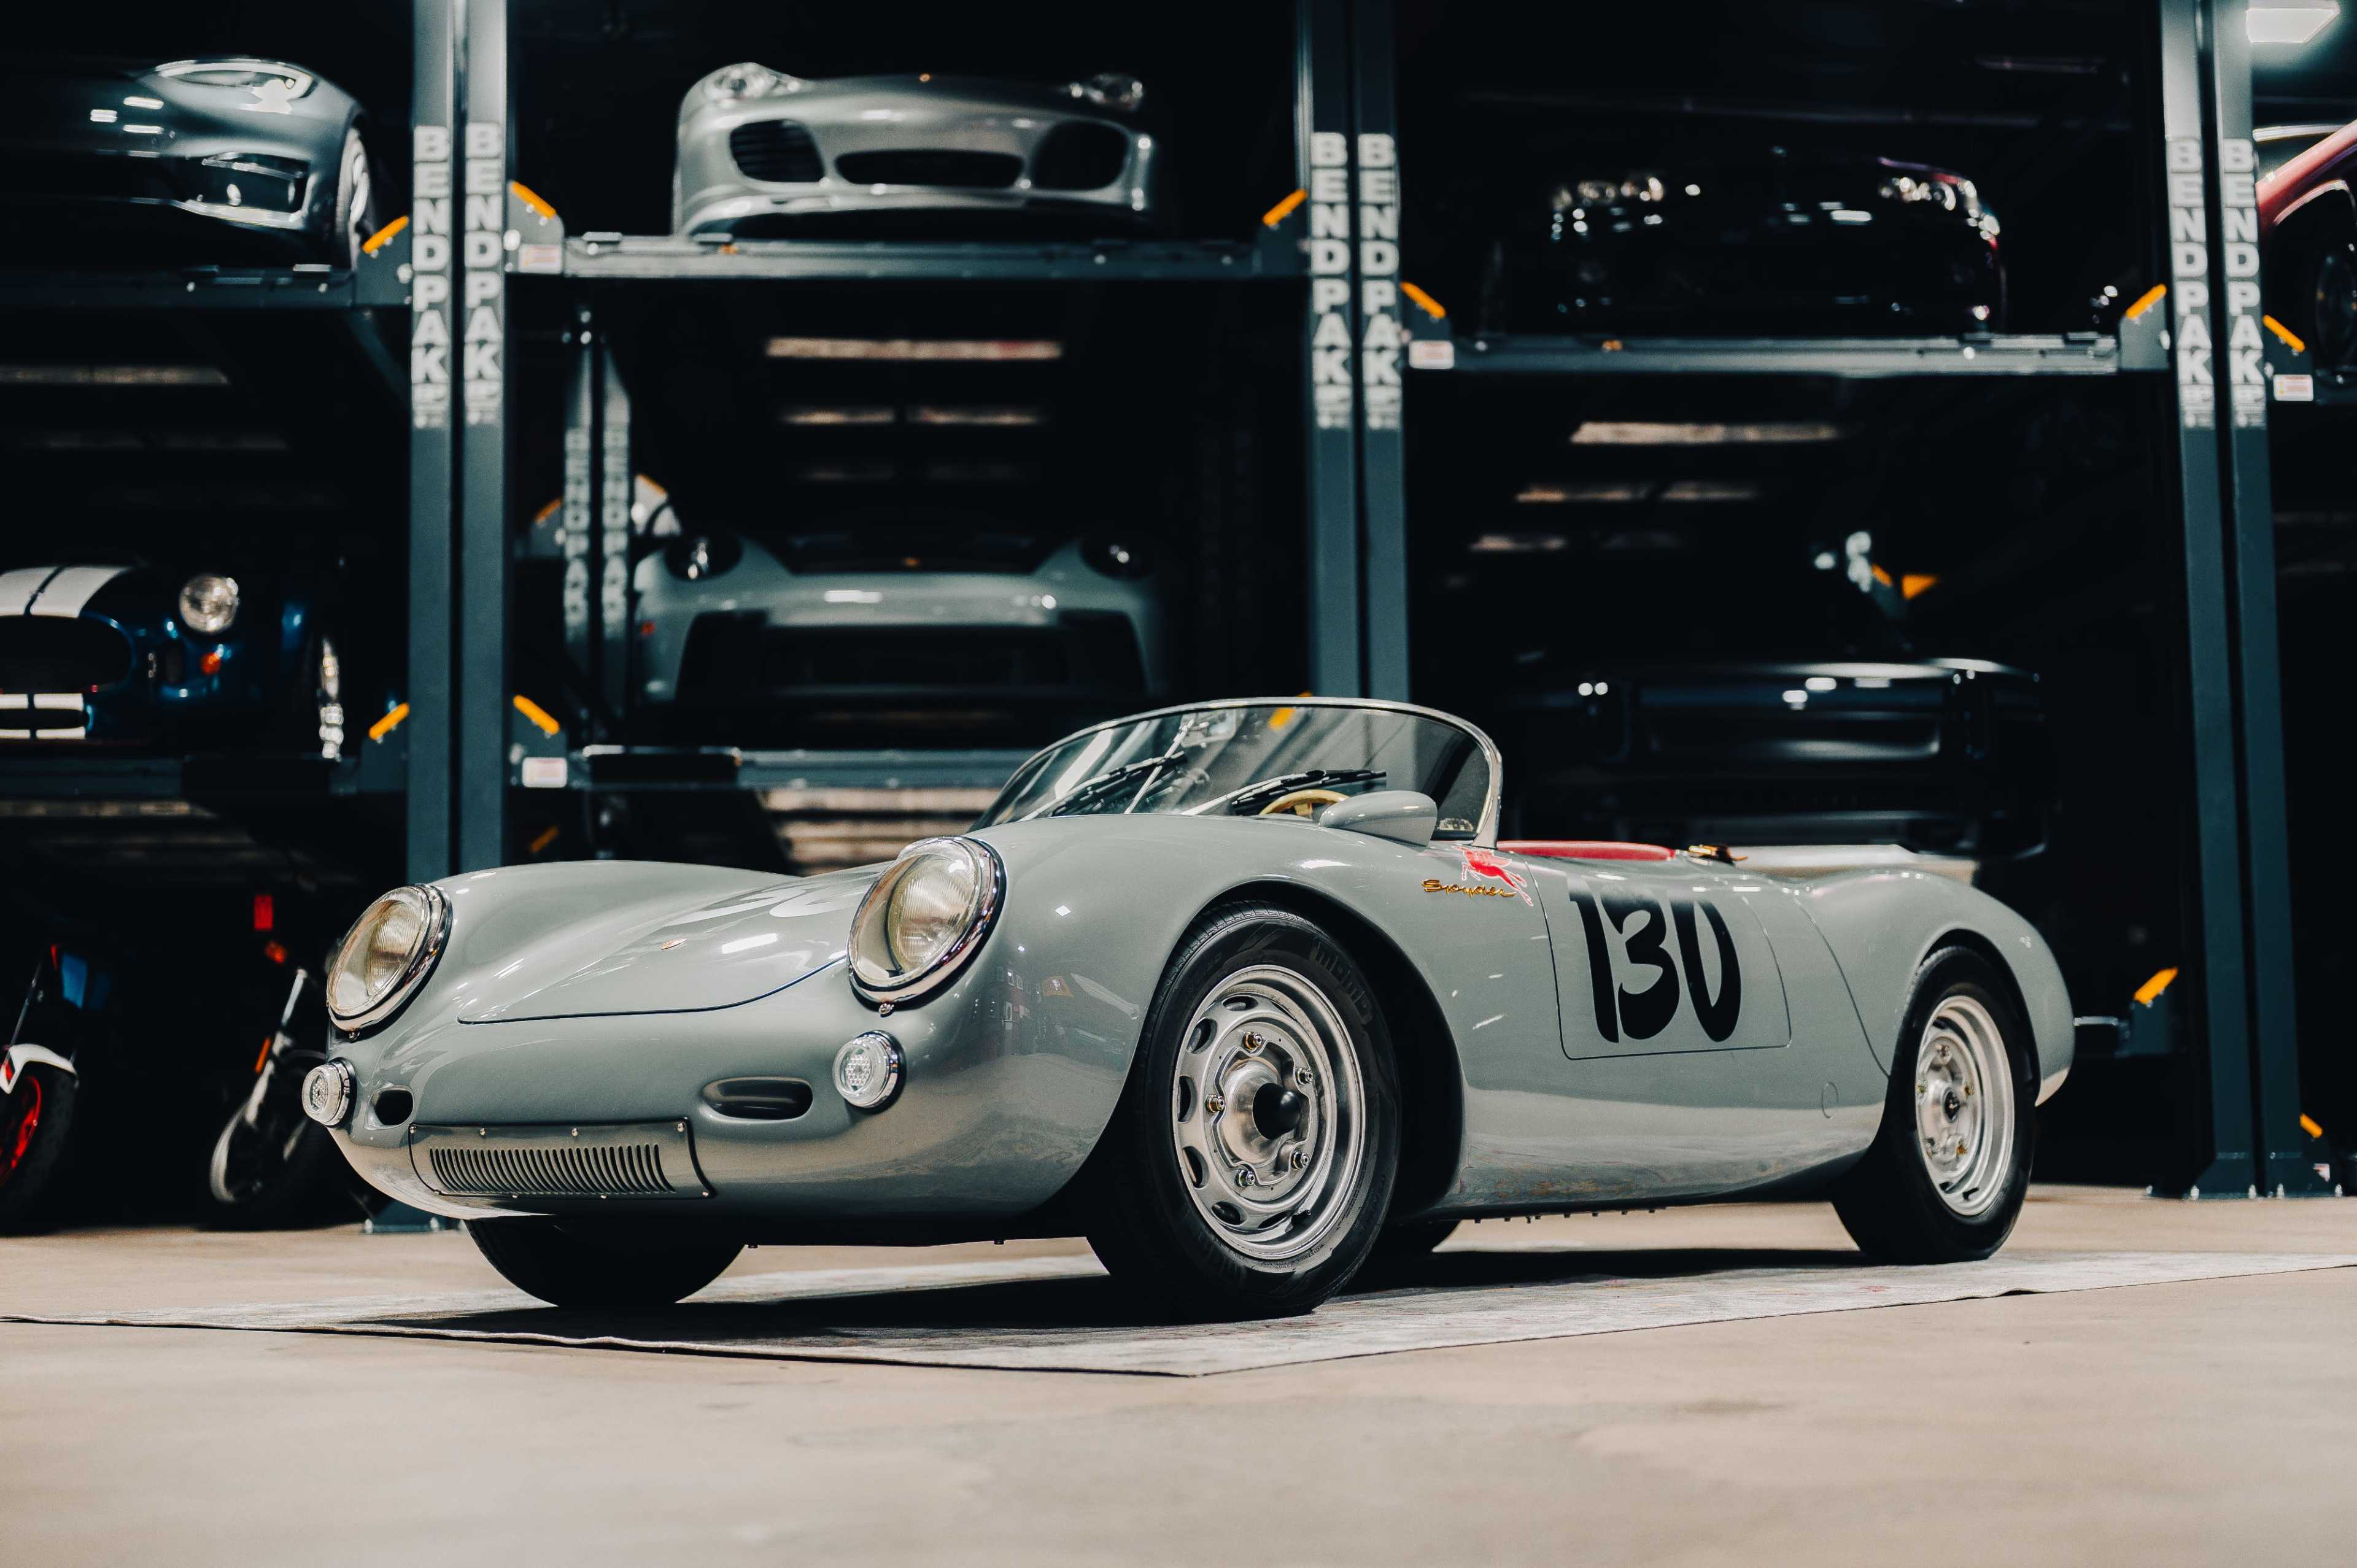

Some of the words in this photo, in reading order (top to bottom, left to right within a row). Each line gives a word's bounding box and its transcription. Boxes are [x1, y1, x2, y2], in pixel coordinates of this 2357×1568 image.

[411, 125, 450, 383] BENDPAK
[464, 122, 502, 381] BENDPAK
[1310, 132, 1351, 385] BENDPAK
[1358, 133, 1401, 385] BENDPAK
[2170, 138, 2213, 385] BENDPAK
[2223, 138, 2265, 385] BENDPAK
[1421, 879, 1516, 898] Spyder
[1567, 873, 1741, 1043] 130
